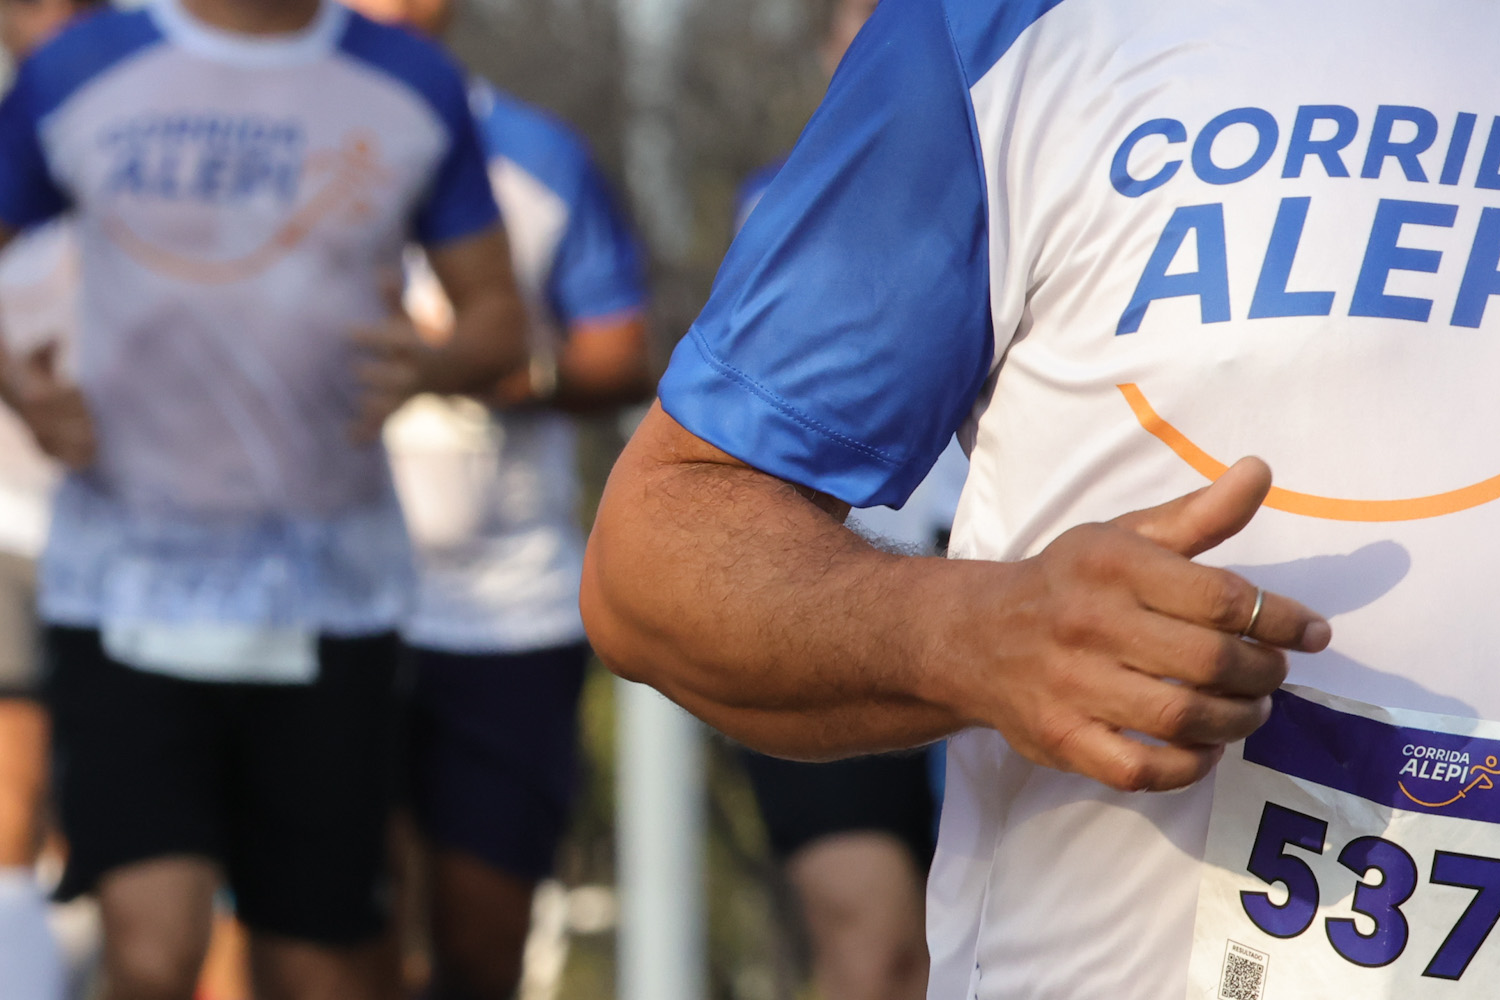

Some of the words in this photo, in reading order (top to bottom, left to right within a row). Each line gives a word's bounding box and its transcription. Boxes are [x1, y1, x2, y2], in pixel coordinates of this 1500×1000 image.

[1402, 744, 1470, 765] CORRIDA
[1399, 758, 1469, 784] ALEPI
[1232, 944, 1263, 961] RESULTADO
